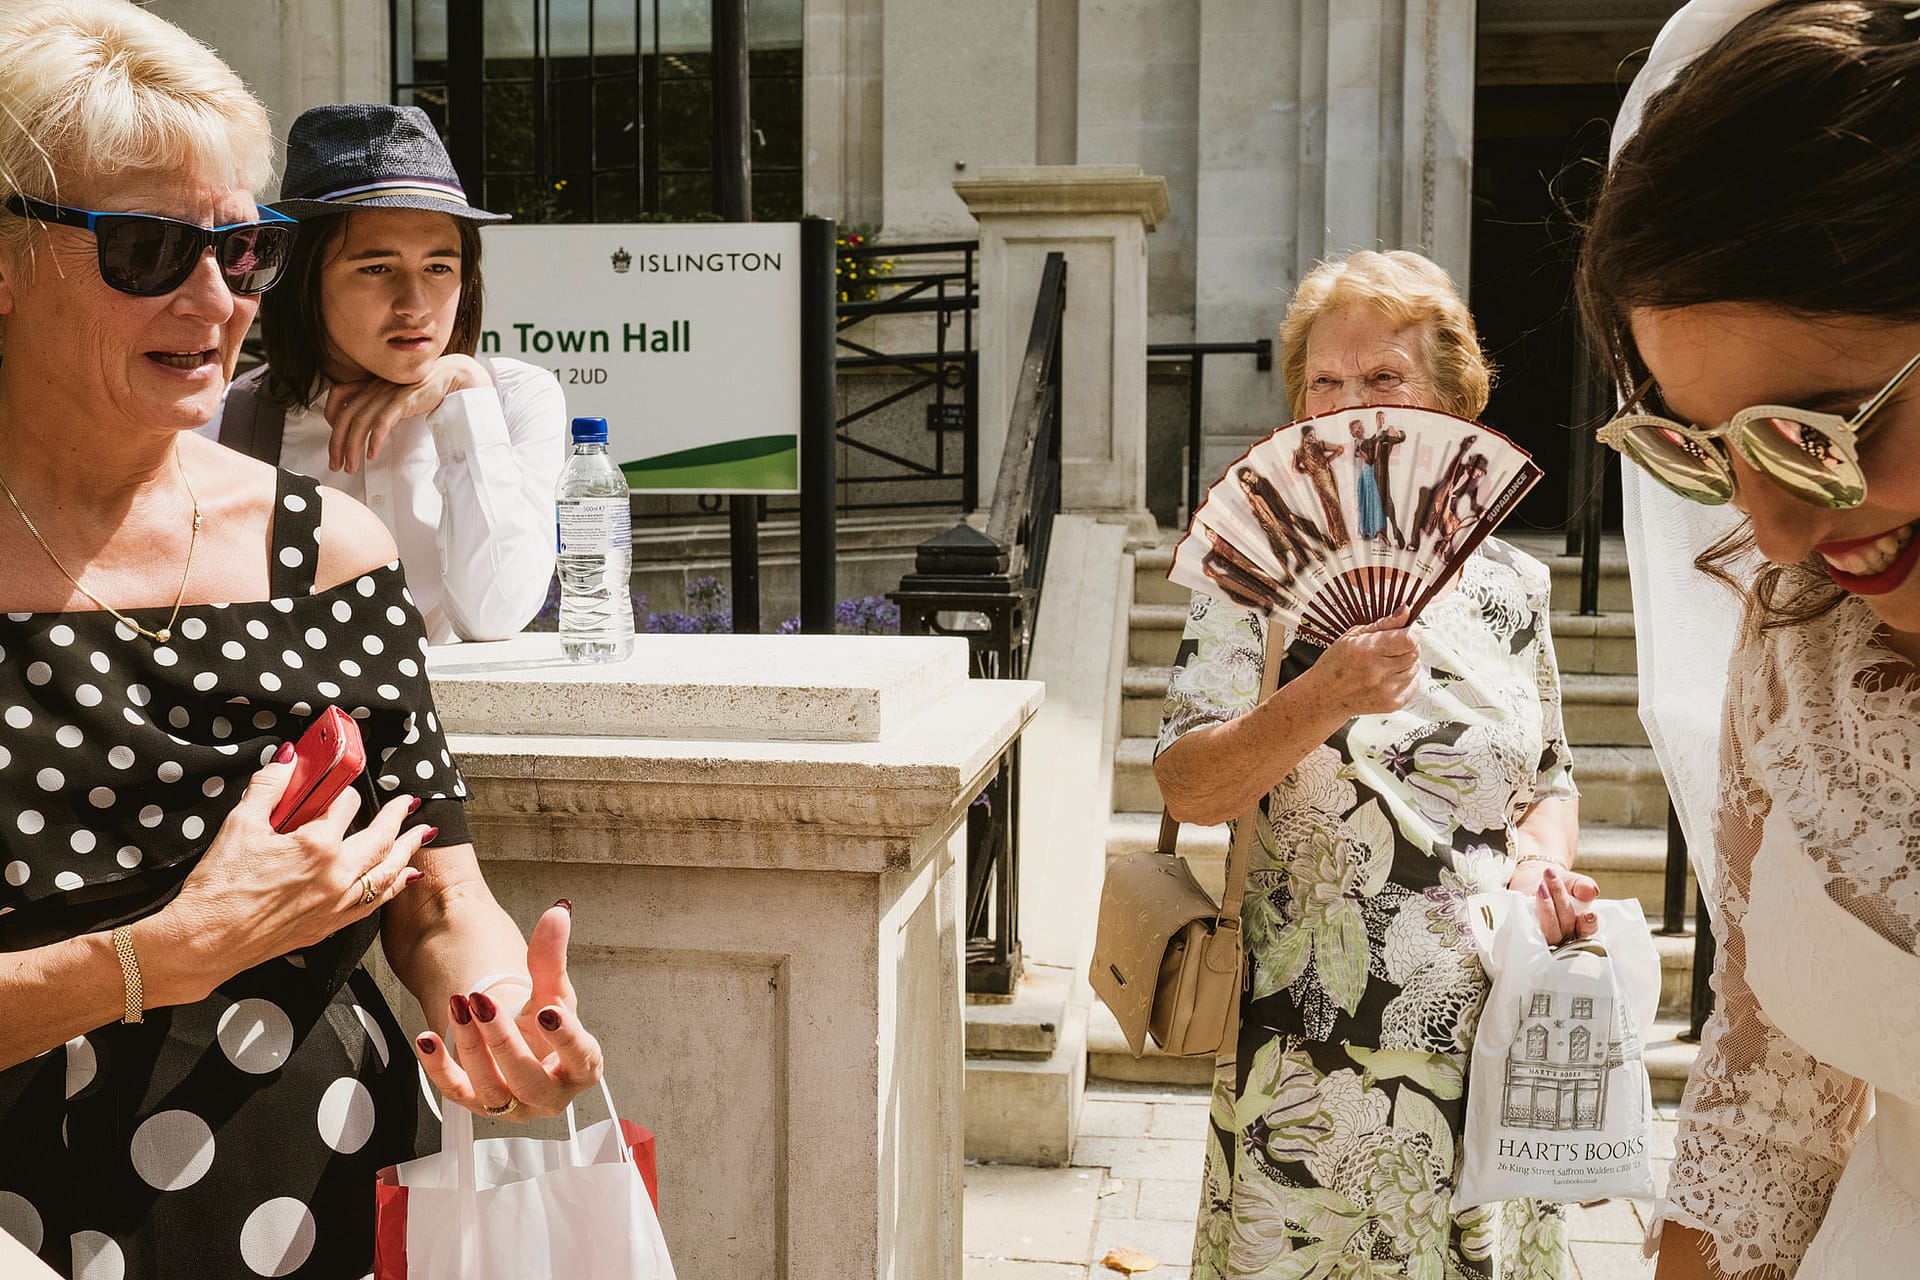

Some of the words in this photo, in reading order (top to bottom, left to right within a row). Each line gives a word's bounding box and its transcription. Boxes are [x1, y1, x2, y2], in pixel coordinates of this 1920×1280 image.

[640, 253, 781, 273] ISLINGTON
[513, 323, 609, 352] Town
[623, 320, 690, 352] Hall
[568, 368, 608, 384] 2UD
[1486, 472, 1527, 522] SUPADANCE
[1498, 1138, 1578, 1161] HART'S
[1585, 1136, 1644, 1161] BOOKS
[1497, 1162, 1507, 1170] 26
[1509, 1164, 1529, 1175] King
[1531, 1167, 1555, 1176] Street
[1557, 1168, 1584, 1176] Saffron
[1587, 1167, 1614, 1175] Walden
